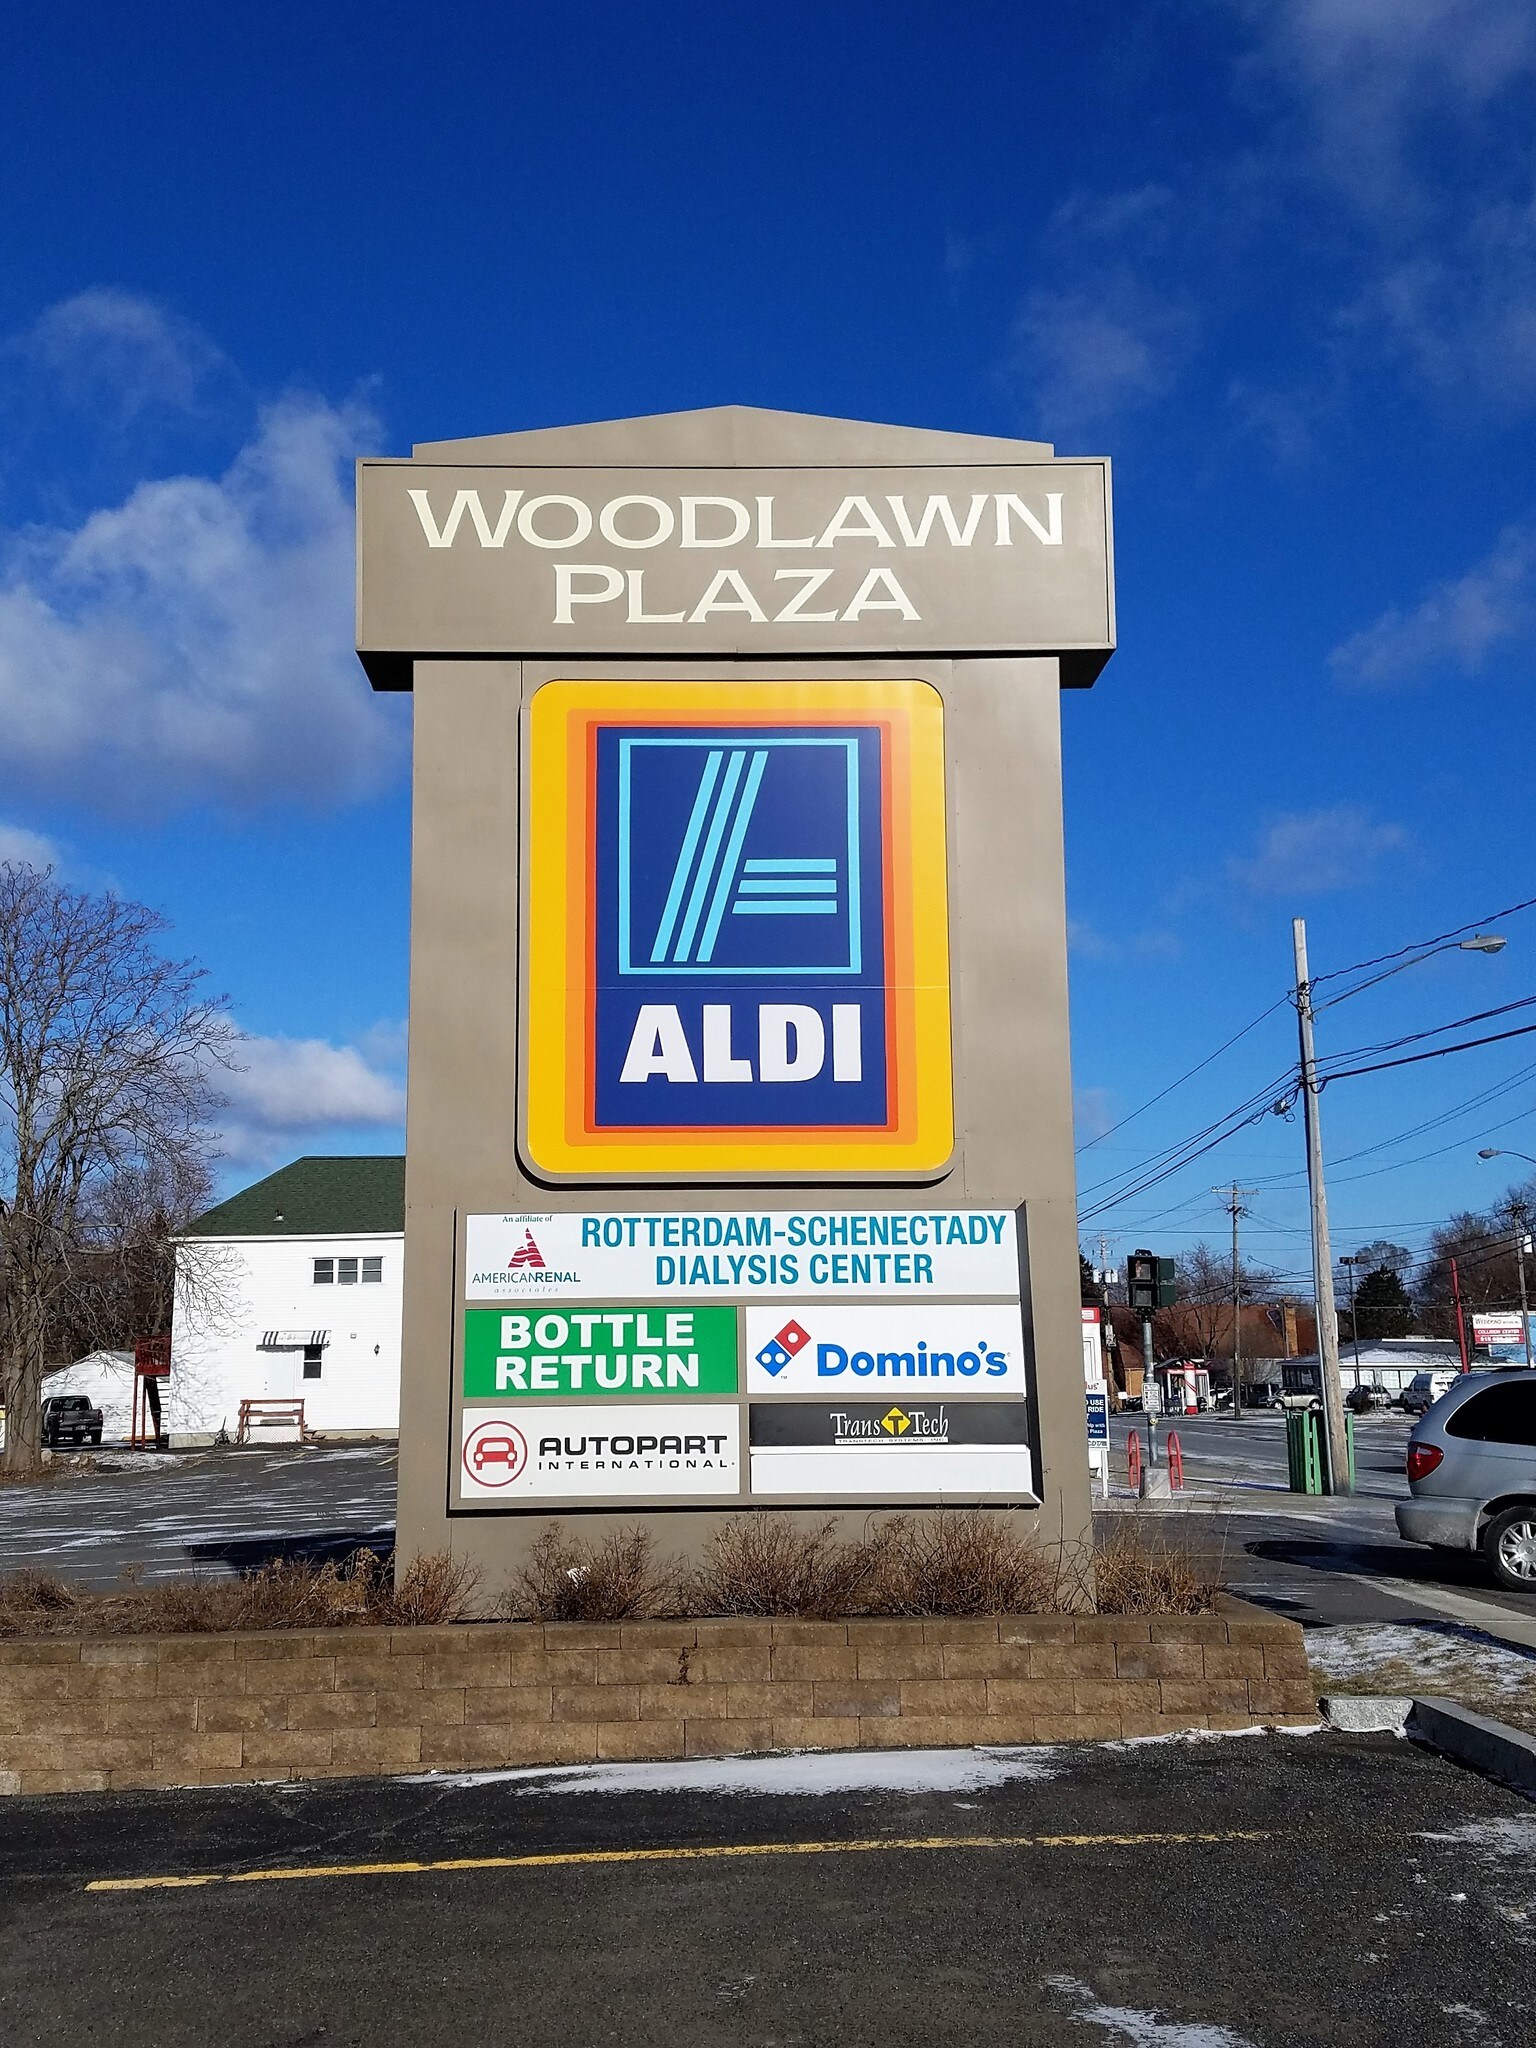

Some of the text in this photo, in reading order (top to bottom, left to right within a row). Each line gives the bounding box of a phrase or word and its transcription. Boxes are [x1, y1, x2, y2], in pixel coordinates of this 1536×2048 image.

[406, 488, 1065, 549] WOODLAWN
[552, 563, 922, 625] PLAZA
[618, 1003, 862, 1083] ALDI
[502, 1214, 554, 1223] An affiliate of
[581, 1215, 1007, 1248] ROTTERDAM-SCHENECTADY
[655, 1253, 934, 1286] DIALYSIS CENTER
[500, 1313, 695, 1349] BOTTLE
[495, 1353, 699, 1390] RETURN
[816, 1341, 1008, 1377] Domino's
[830, 1413, 881, 1437] Trans
[908, 1405, 949, 1438] Tech
[539, 1435, 728, 1457] AUTOPART
[538, 1459, 728, 1470] INTERNATIONAL
